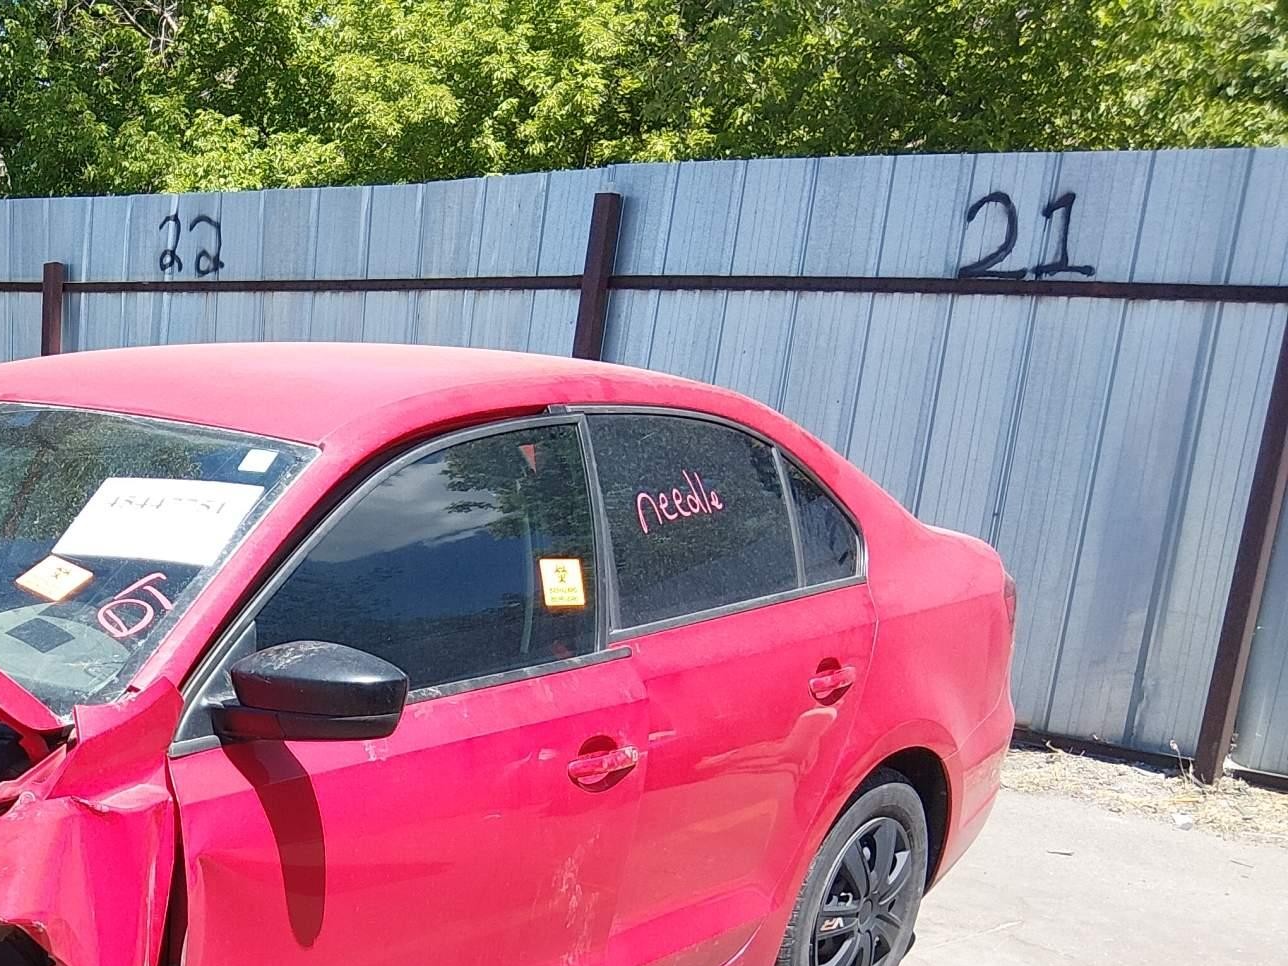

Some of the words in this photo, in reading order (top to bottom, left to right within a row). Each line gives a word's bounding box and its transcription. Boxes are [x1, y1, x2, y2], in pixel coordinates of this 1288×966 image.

[159, 212, 224, 278] 22
[958, 191, 1095, 280] 21
[636, 470, 723, 534] needle
